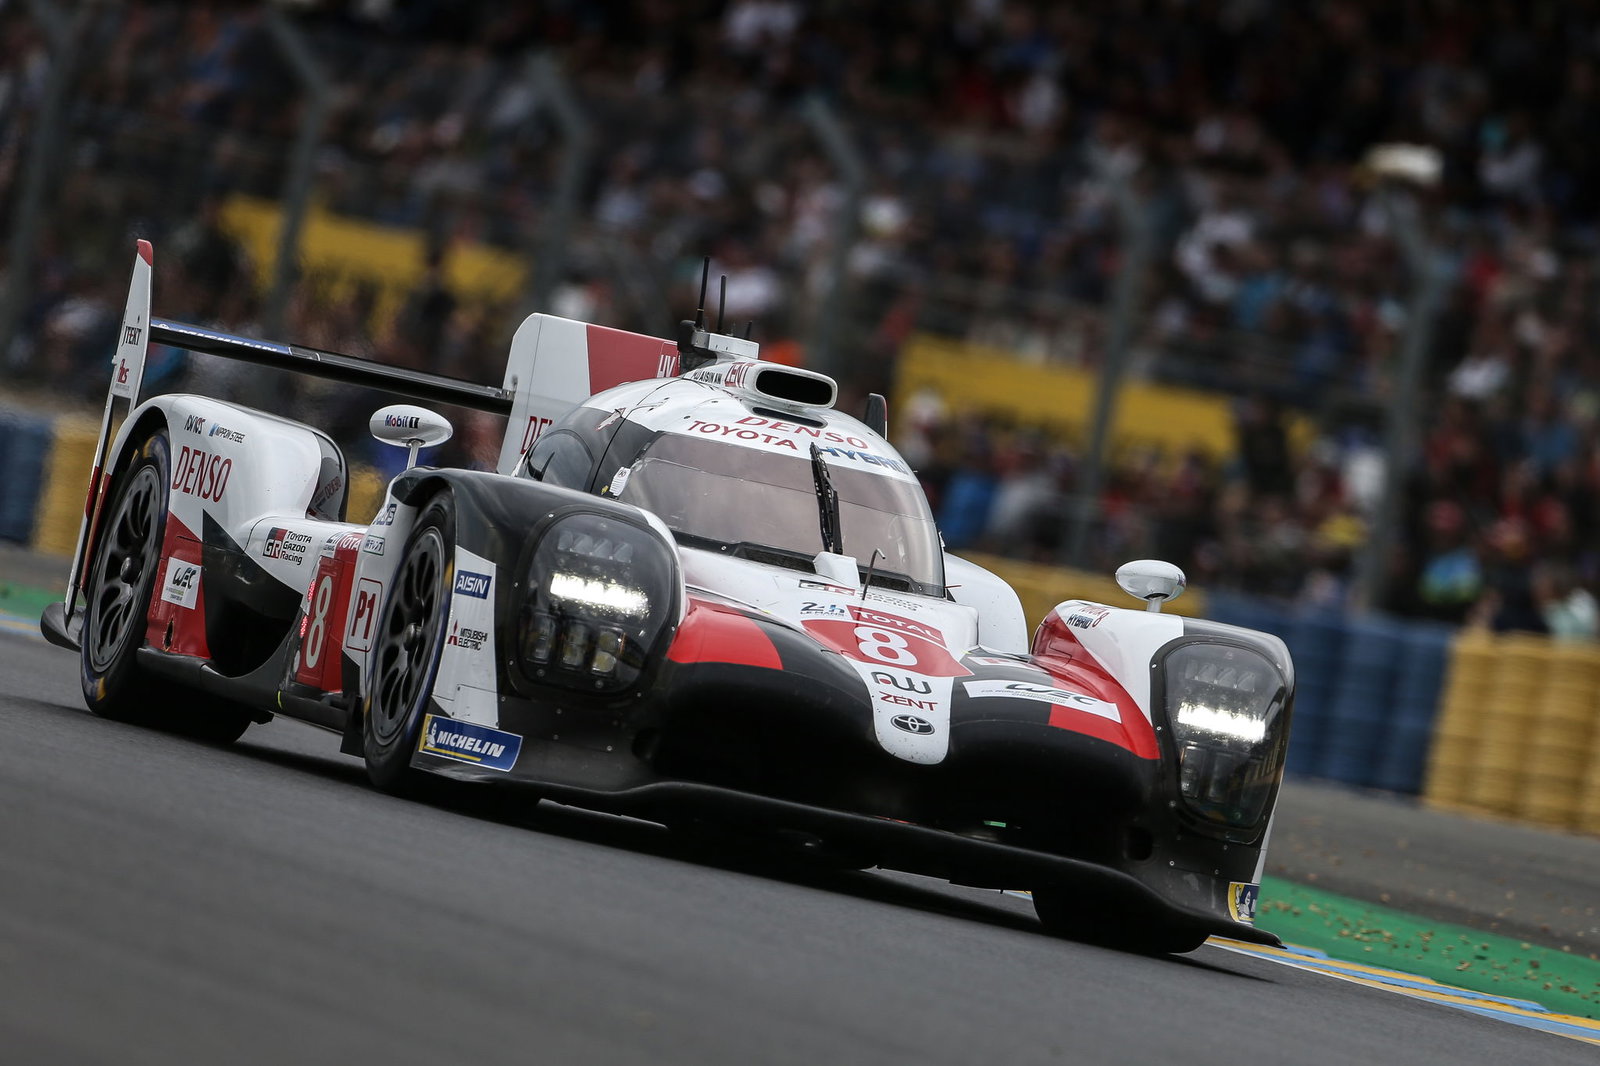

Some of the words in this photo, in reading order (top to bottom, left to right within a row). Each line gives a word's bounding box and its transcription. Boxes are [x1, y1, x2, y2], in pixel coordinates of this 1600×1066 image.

[385, 414, 409, 428] Mobil
[688, 420, 799, 451] TOYOTA
[735, 416, 869, 450] DENSO
[172, 445, 233, 504] DENSO
[280, 551, 304, 566] Racing
[456, 575, 488, 594] AISIN
[305, 575, 332, 669] 8
[351, 590, 377, 641] P1
[853, 609, 944, 642] TOTAL
[457, 638, 482, 652] ELECTRIC
[459, 627, 488, 643] MITSUBISHI
[854, 626, 918, 667] 8
[878, 691, 939, 711] ZENT
[436, 730, 506, 757] MICHELIN
